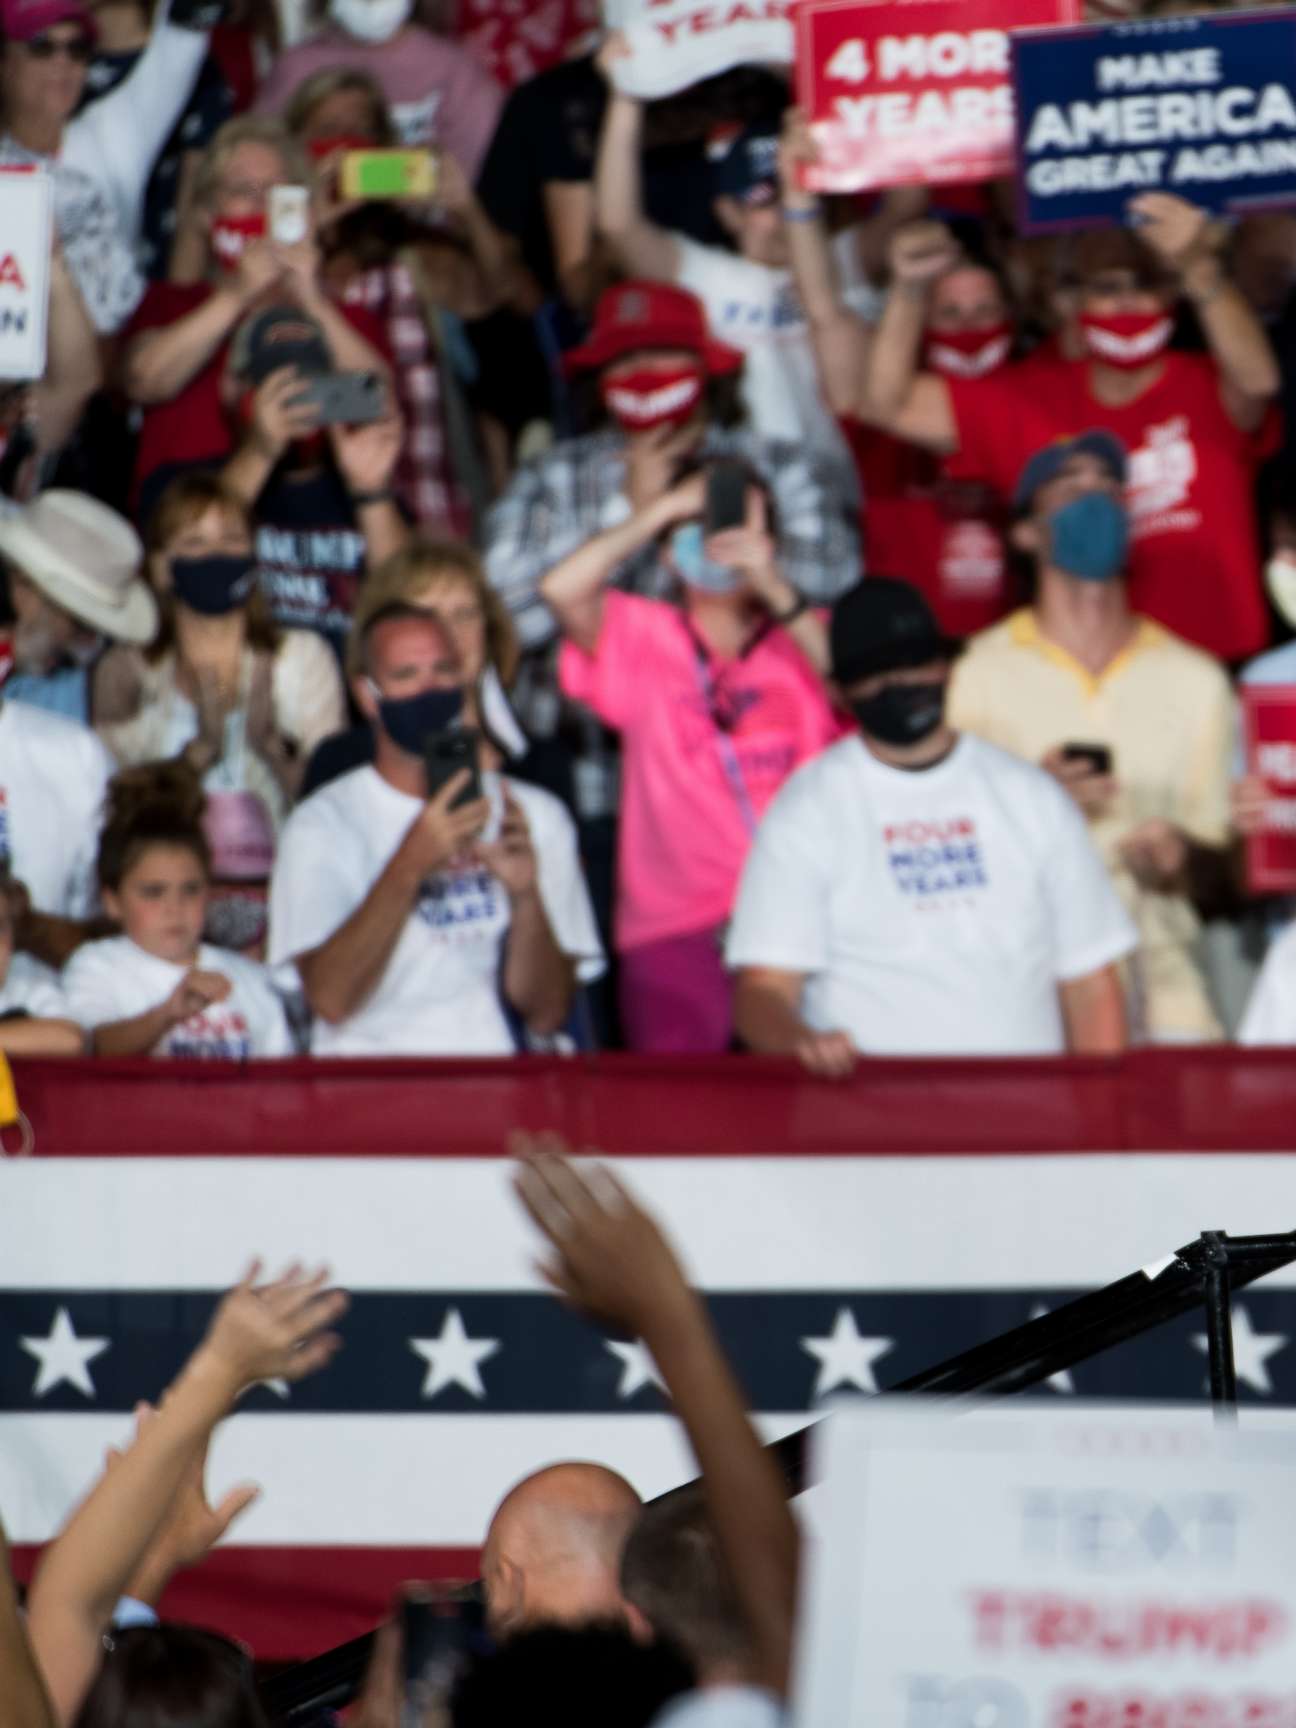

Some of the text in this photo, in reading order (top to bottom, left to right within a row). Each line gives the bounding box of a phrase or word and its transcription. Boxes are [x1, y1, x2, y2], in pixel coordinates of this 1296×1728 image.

[653, 1, 799, 46] YEAR
[825, 29, 1010, 84] 4 MOR
[1097, 47, 1222, 91] MAKE
[1027, 149, 1165, 196] GREAT
[883, 818, 977, 847] FOUR
[889, 843, 983, 870] MORE
[897, 868, 989, 896] YEARS
[1018, 1490, 1240, 1574] TEXT
[969, 1588, 1290, 1660] TRUMP
